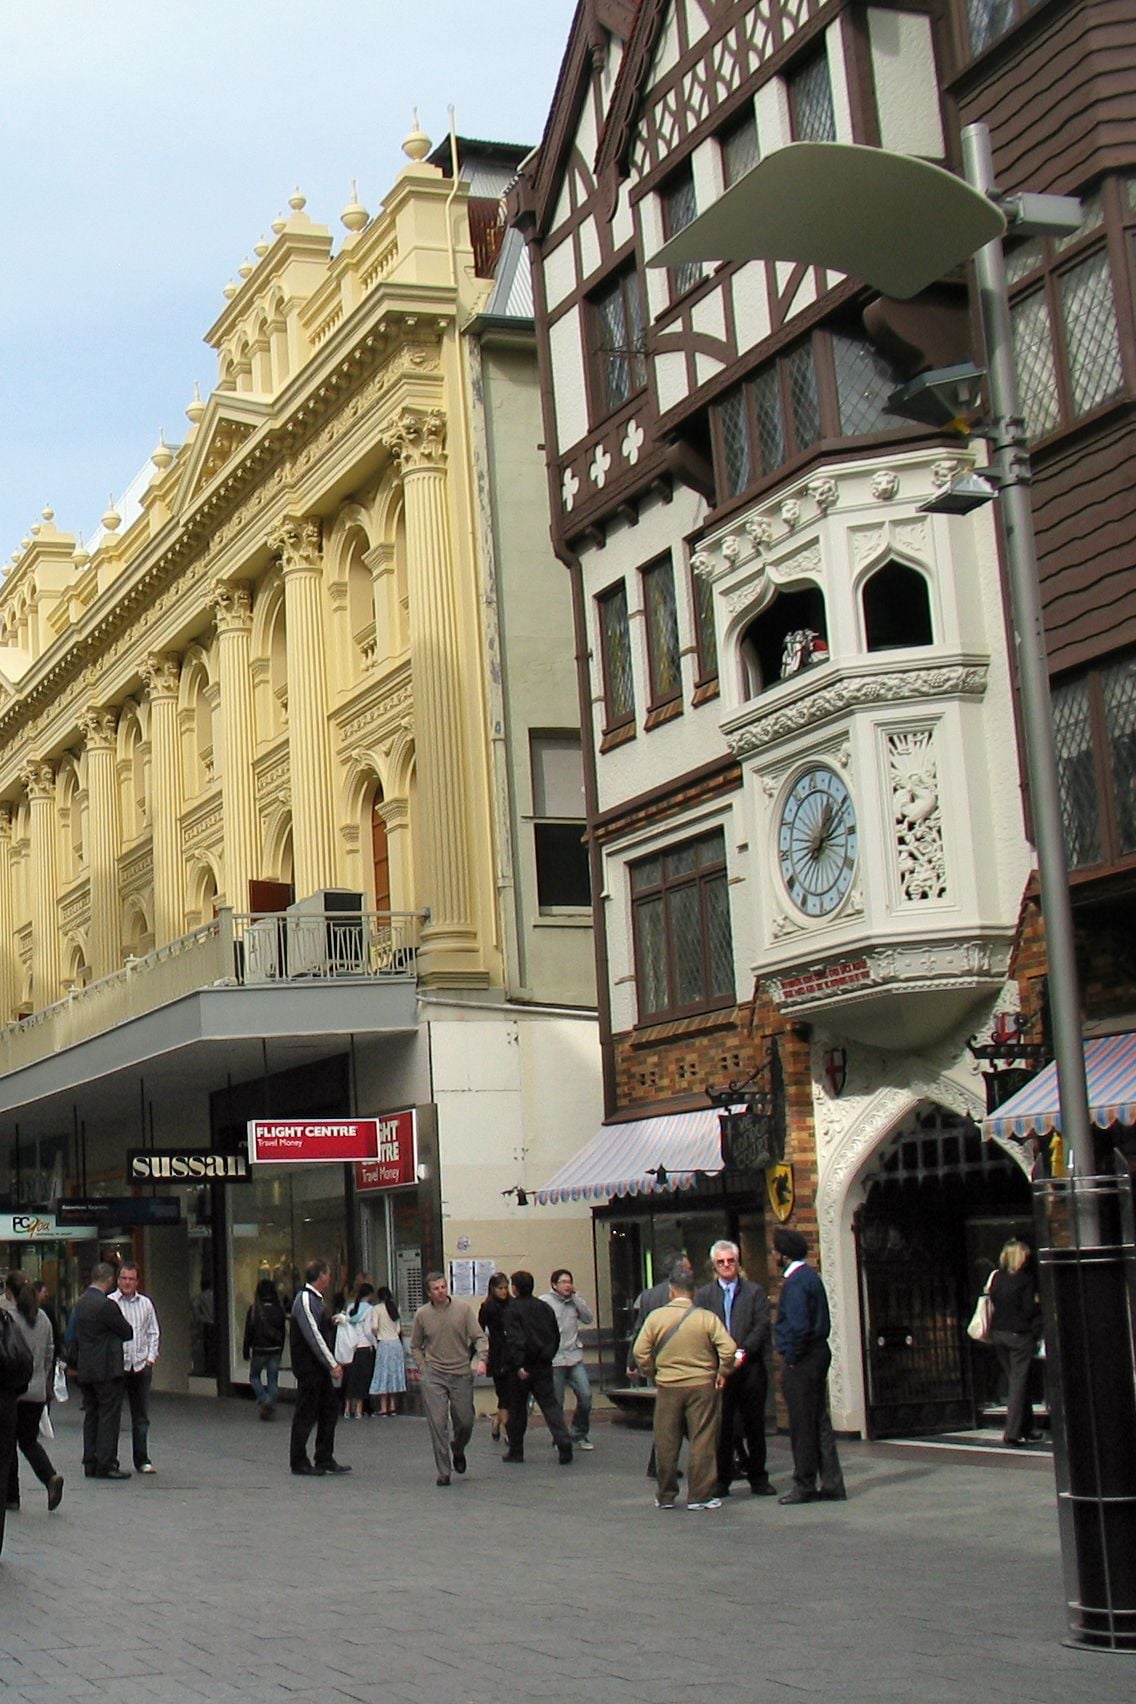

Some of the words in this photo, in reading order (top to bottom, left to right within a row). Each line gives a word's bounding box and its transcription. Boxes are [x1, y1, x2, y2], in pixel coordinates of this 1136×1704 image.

[256, 1126, 304, 1138] FLIGHT
[304, 1125, 357, 1137] CENTRE
[257, 1138, 278, 1147] Travel
[279, 1138, 304, 1148] Money
[132, 1155, 247, 1178] sussan
[362, 1169, 379, 1183] Travel
[379, 1166, 400, 1182] Money
